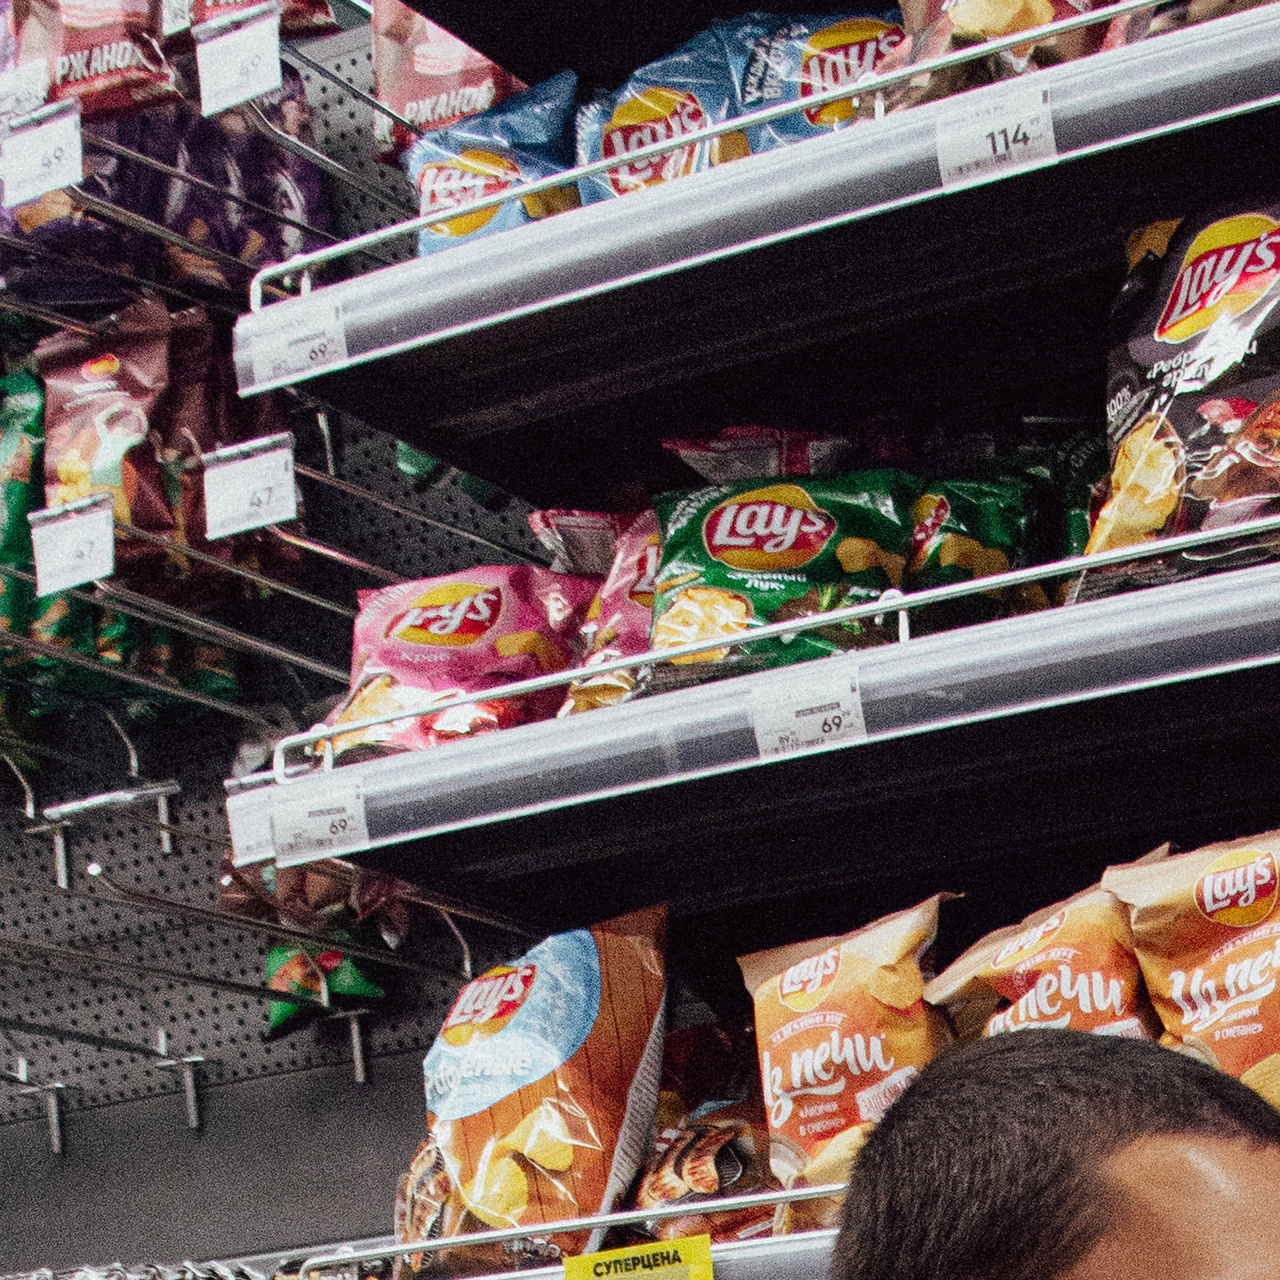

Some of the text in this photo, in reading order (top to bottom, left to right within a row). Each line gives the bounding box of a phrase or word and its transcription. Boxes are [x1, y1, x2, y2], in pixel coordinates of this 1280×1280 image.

[986, 122, 1031, 157] 114
[821, 715, 843, 734] 69
[1202, 856, 1272, 913] Lay's
[791, 1030, 896, 1089] печи
[592, 1249, 683, 1278] СУПЕРЦЕНА
